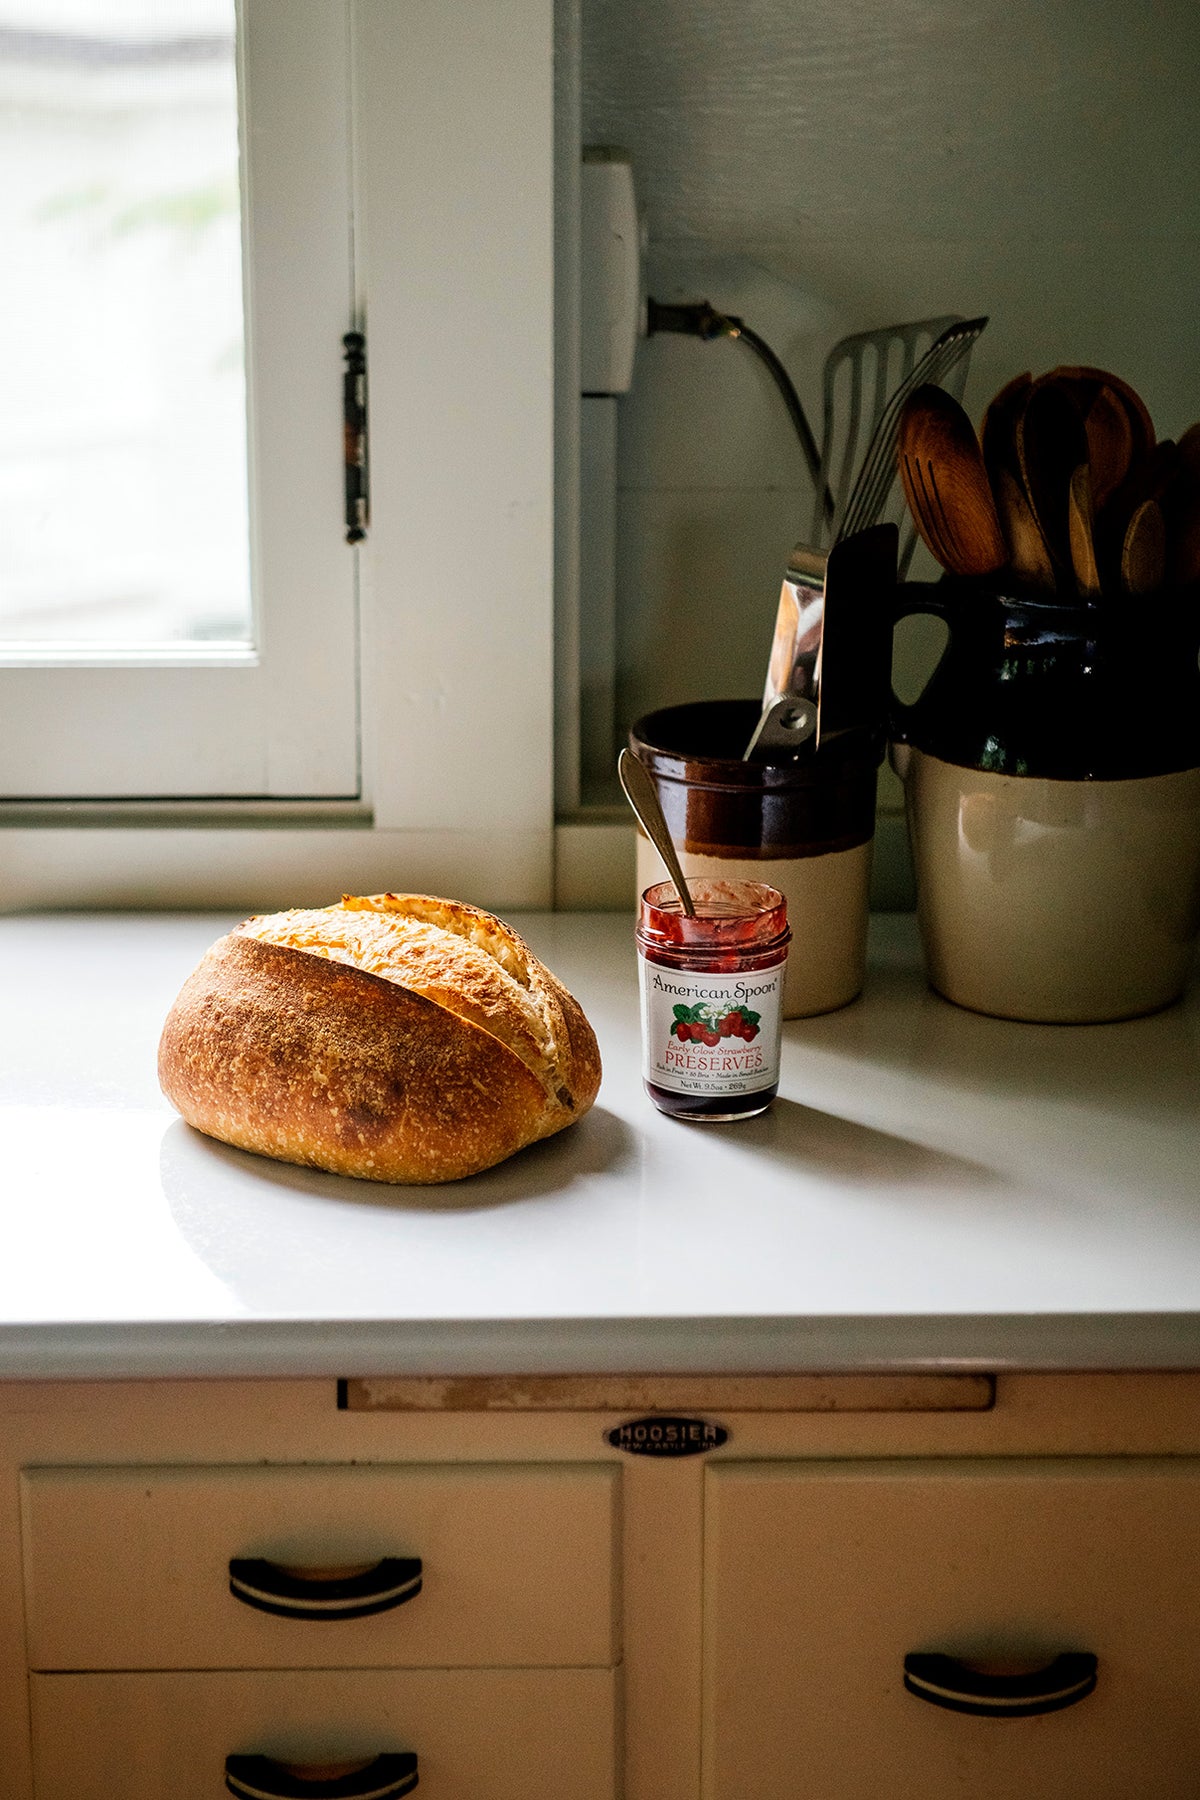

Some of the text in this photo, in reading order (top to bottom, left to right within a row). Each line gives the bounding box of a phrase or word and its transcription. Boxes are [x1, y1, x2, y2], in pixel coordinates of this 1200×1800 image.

[653, 974, 776, 1003] American Spoon
[667, 1040, 763, 1056] Early Glow Strawberry
[665, 1050, 763, 1071] PRESERVES
[681, 1080, 691, 1089] Net
[619, 1425, 716, 1442] HOOSIER
